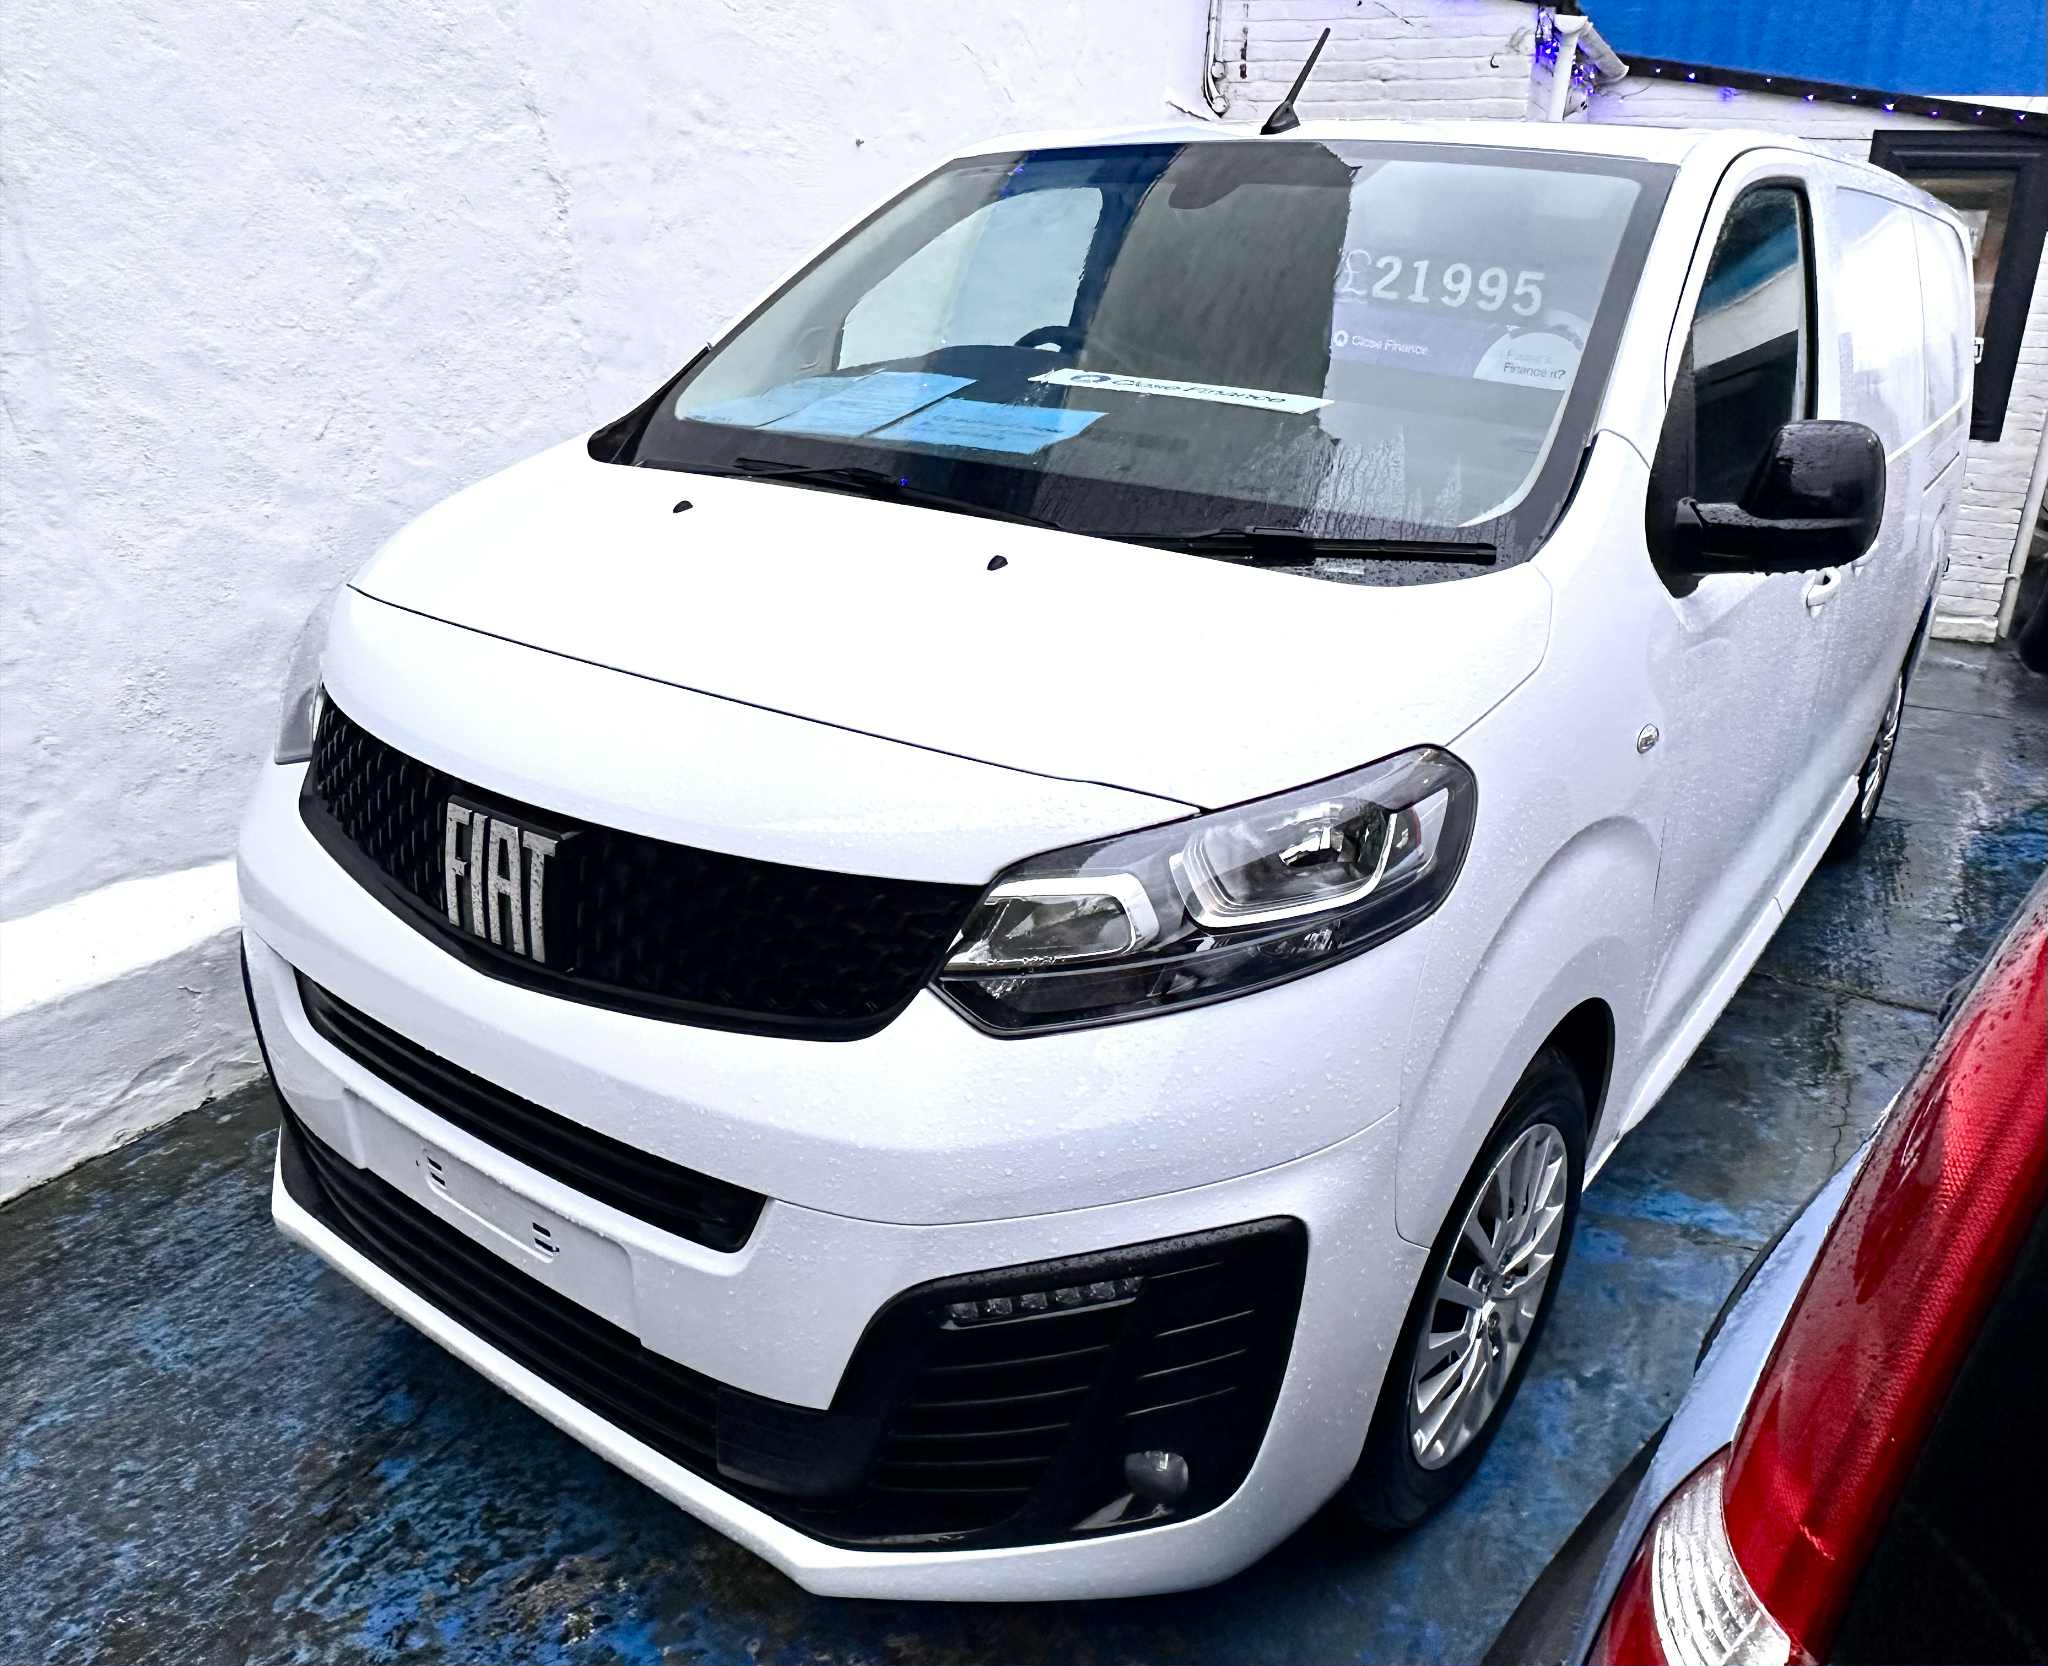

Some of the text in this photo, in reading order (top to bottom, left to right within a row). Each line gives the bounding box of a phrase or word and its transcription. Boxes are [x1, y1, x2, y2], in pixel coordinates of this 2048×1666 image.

[1340, 249, 1546, 317] £21995
[1503, 362, 1547, 378] Finance
[1183, 386, 1288, 404] Finance
[445, 802, 559, 963] FIAT
